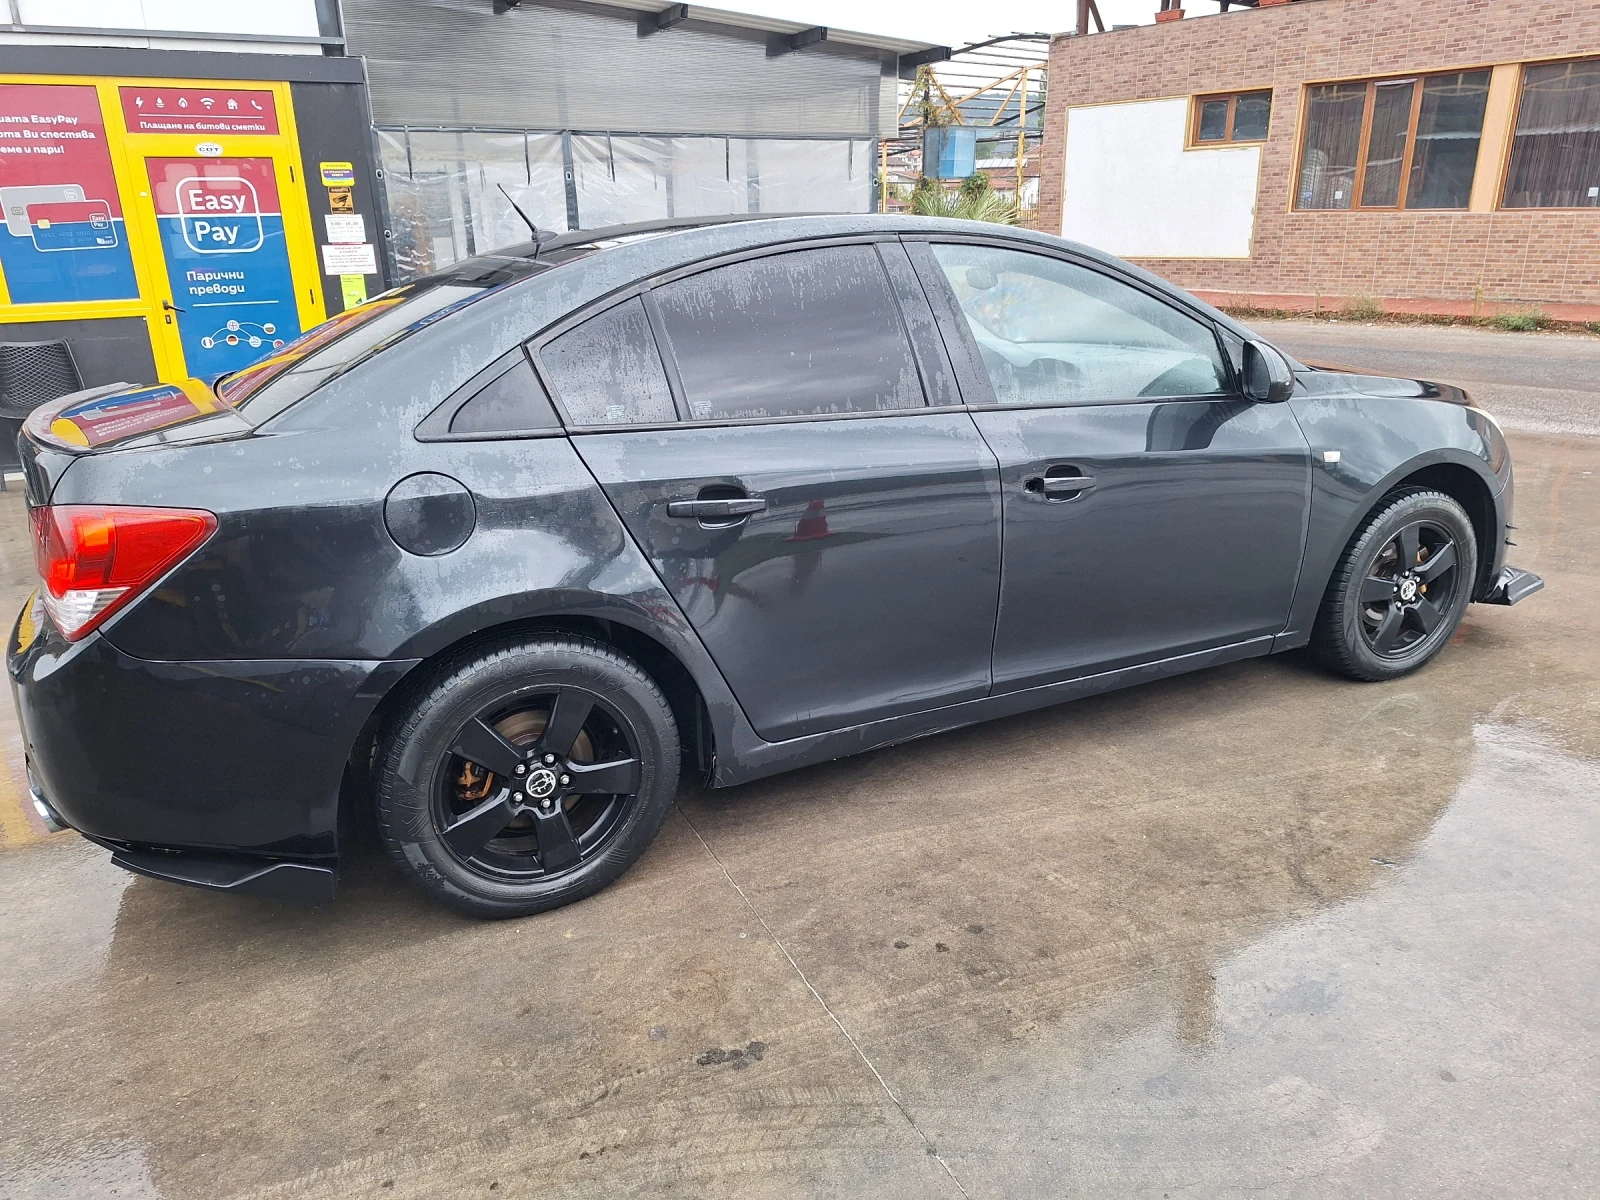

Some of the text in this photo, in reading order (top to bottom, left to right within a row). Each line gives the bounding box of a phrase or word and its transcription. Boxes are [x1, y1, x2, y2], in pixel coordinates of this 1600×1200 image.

[31, 114, 78, 126] EasyPay
[139, 121, 182, 130] Плащане
[196, 121, 230, 131] битови
[231, 123, 266, 131] сметки
[23, 129, 39, 139] Ви
[40, 129, 96, 139] спестява
[24, 146, 31, 154] и
[33, 145, 65, 156] пари!
[188, 189, 246, 213] Easy
[194, 221, 238, 245] Pay
[186, 270, 245, 282] Парични
[189, 283, 245, 296] преводи
